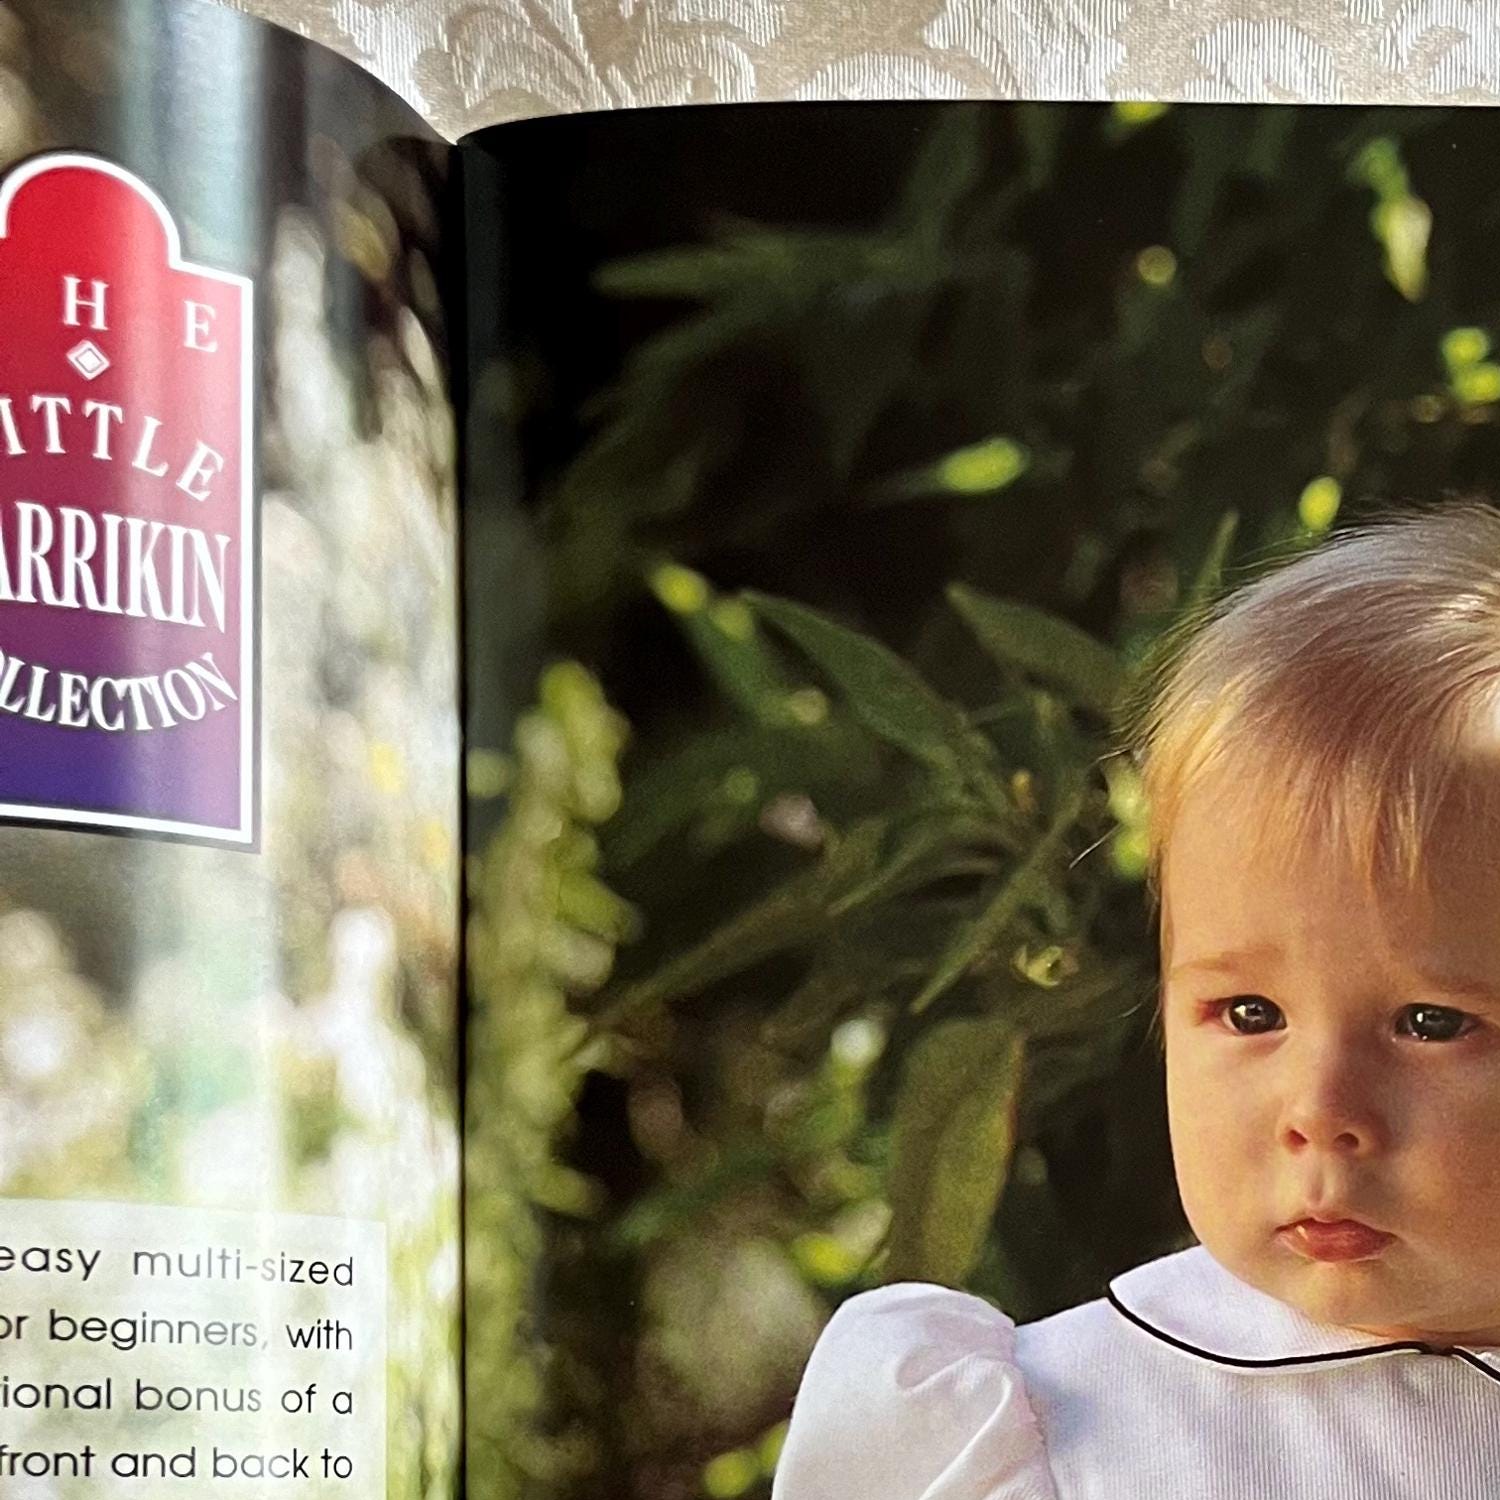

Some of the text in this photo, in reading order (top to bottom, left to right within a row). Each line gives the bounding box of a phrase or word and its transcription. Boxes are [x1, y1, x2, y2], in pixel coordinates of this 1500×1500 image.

[0, 652, 238, 731] LLECTION
[133, 1248, 353, 1286] multi-sized
[49, 1308, 267, 1351] beginners,
[285, 1318, 352, 1350] with
[136, 1378, 261, 1412] bonus
[281, 1383, 317, 1413] of
[332, 1392, 352, 1414] a
[111, 1446, 196, 1478] and
[213, 1447, 309, 1478] back
[320, 1448, 352, 1479] to
